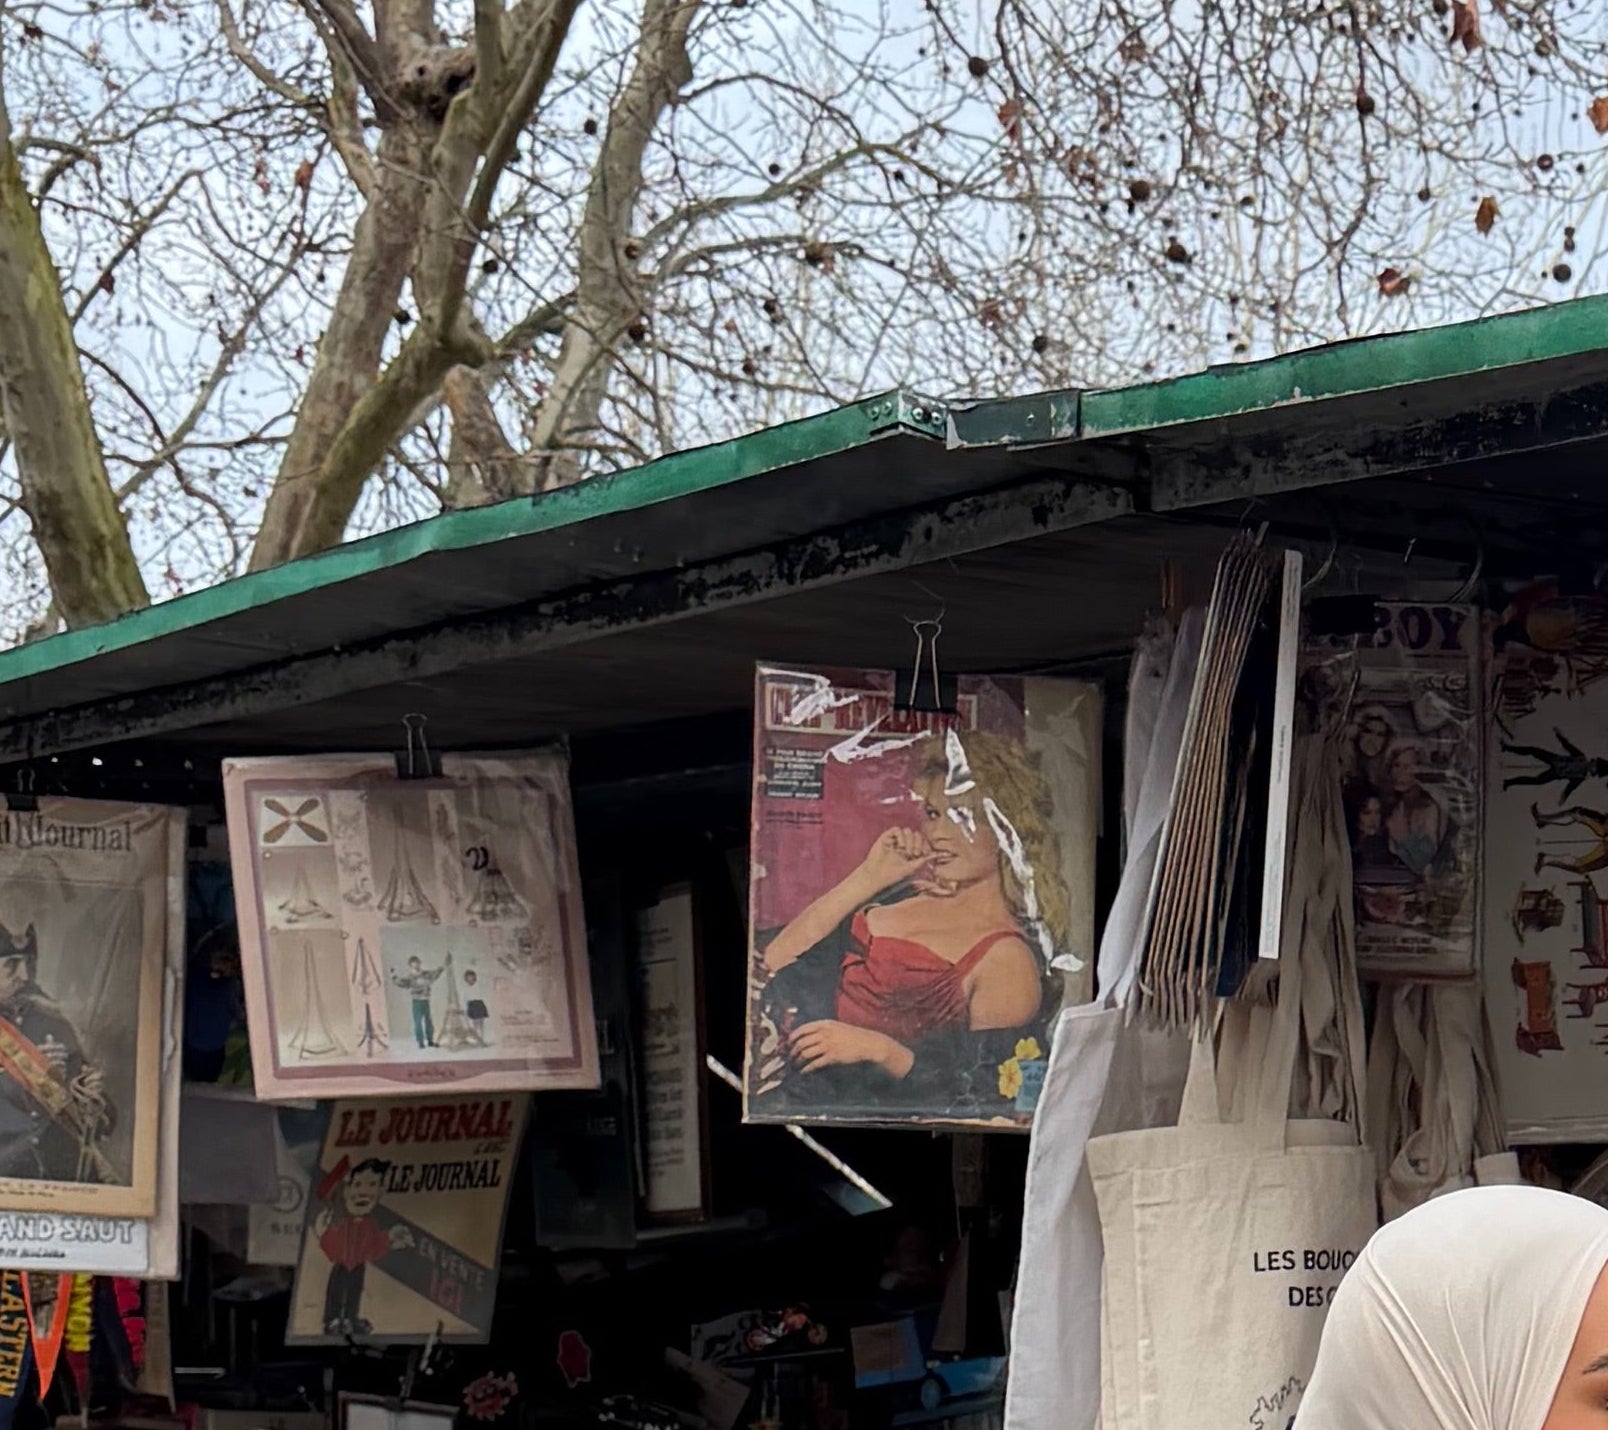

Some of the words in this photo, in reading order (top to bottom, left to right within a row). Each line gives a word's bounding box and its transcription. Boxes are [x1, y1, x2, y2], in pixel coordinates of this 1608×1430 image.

[334, 1109, 375, 1148] LE
[378, 1100, 513, 1146] JOURNAL
[386, 1163, 412, 1194] LE
[412, 1158, 502, 1192] JOURNAL
[61, 1219, 134, 1245] SAUT
[1253, 1249, 1296, 1273] LES
